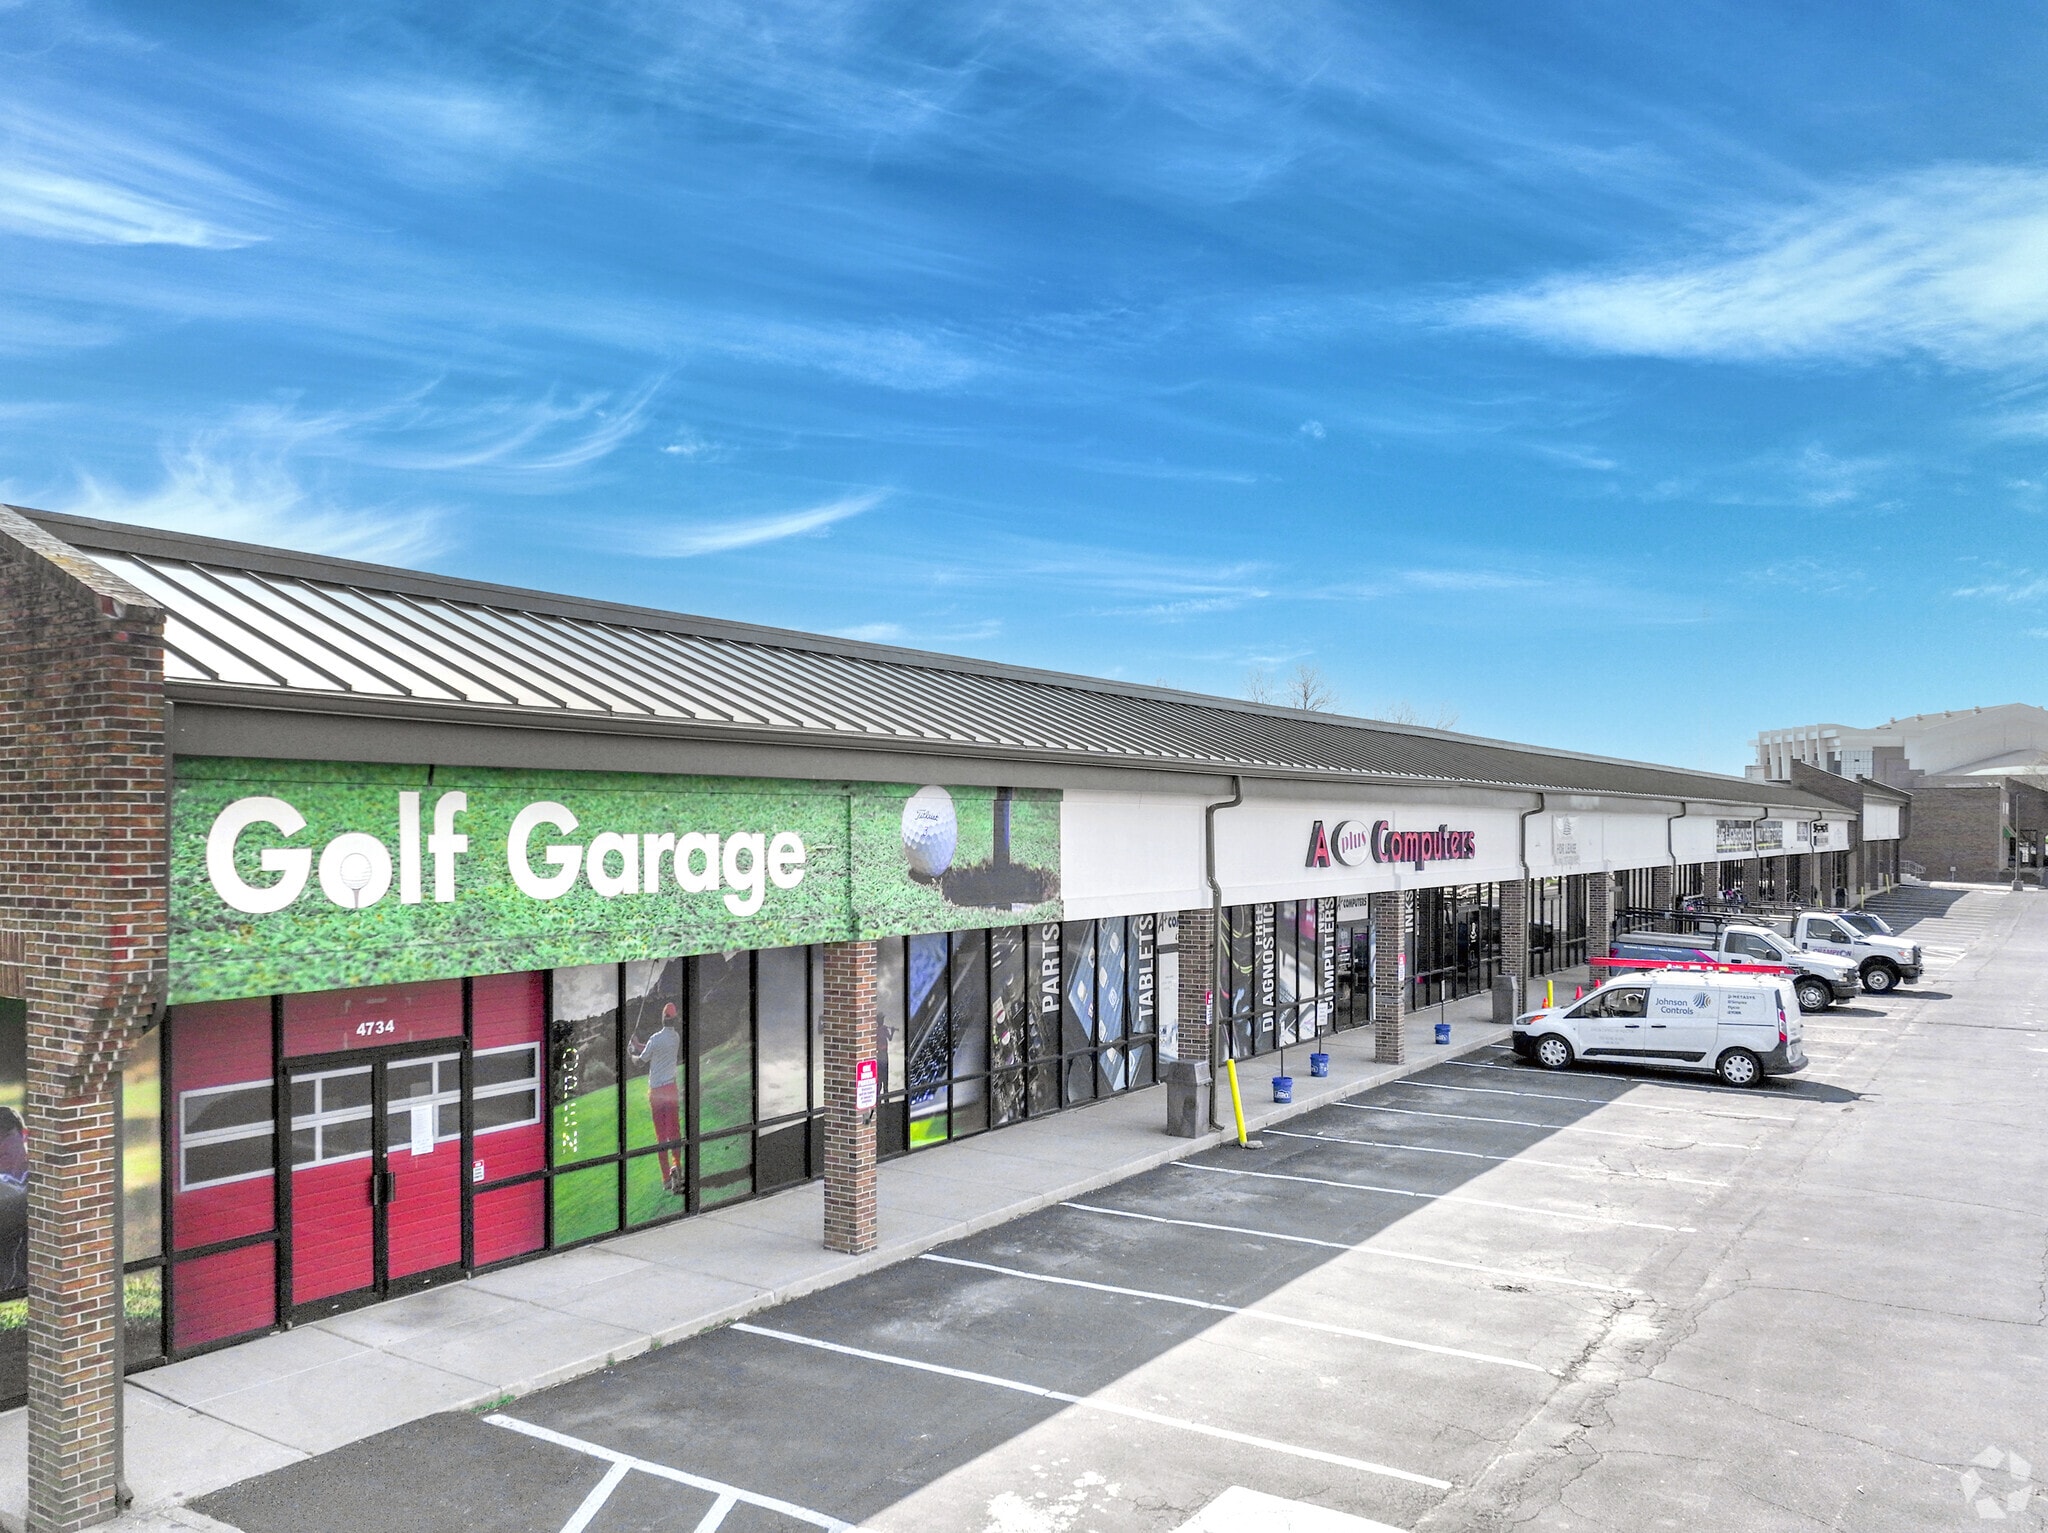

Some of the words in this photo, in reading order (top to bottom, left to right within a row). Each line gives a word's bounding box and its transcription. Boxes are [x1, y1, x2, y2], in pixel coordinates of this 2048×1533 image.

[206, 790, 468, 914] Golf
[507, 801, 806, 917] Garage
[1305, 820, 1331, 868] A
[1341, 830, 1367, 854] plus
[1371, 820, 1475, 871] Computers
[1255, 903, 1263, 946] FREE
[1318, 898, 1326, 933] NEW
[1343, 897, 1367, 908] COMPUTERS
[1405, 890, 1414, 933] INKS
[1041, 923, 1060, 1014] PARTS
[1138, 915, 1154, 1022] TABLETS
[1262, 903, 1275, 1033] DIAGNOSTIC
[1324, 897, 1335, 1014] COMPUTERS
[1655, 998, 1688, 1006] Johnson
[1660, 1006, 1694, 1015] Controls
[356, 1020, 395, 1036] 4734
[563, 1048, 579, 1155] OPEN
